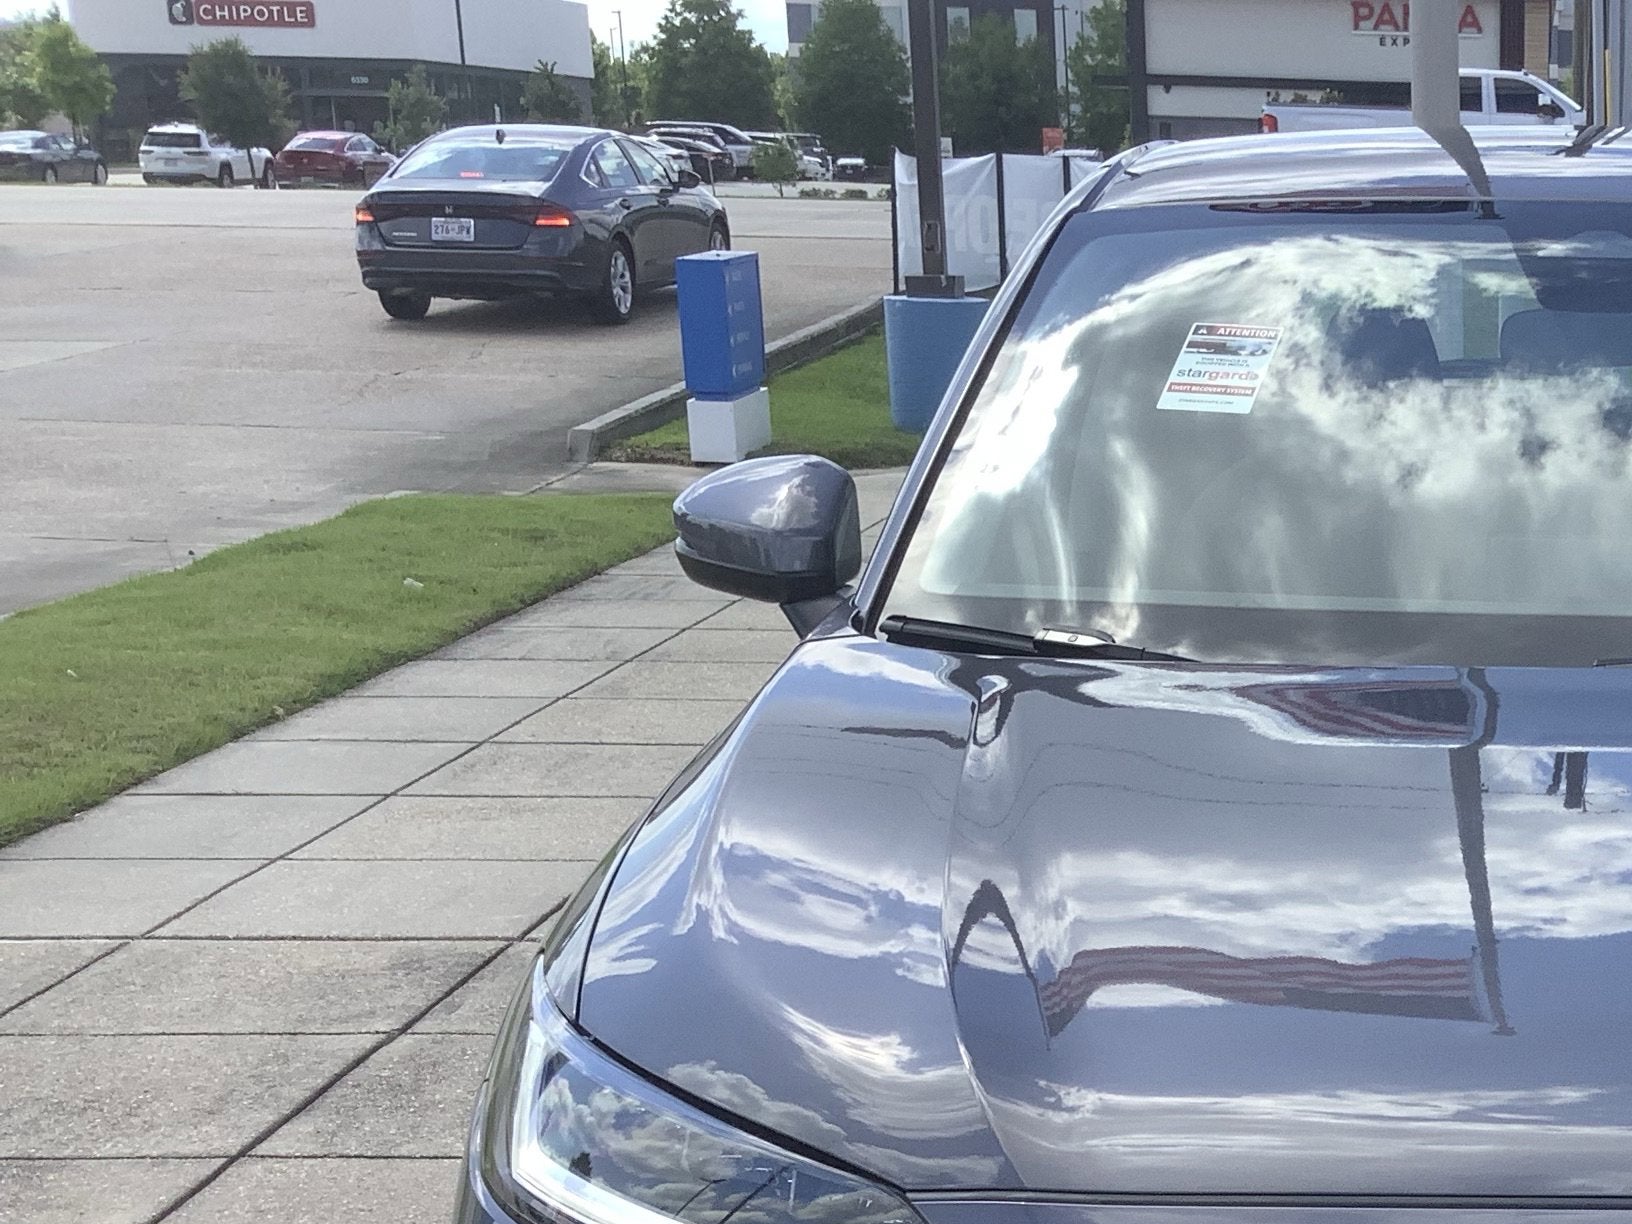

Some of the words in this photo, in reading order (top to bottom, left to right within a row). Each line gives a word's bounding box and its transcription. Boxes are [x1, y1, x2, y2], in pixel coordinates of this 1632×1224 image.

[199, 4, 309, 22] CHIPOTLE
[1351, 0, 1482, 34] PAA
[1217, 327, 1277, 338] ATTENTION
[1170, 384, 1192, 392] THEFT
[1191, 386, 1226, 394] RECOVERY
[1226, 387, 1253, 395] SYSTEM
